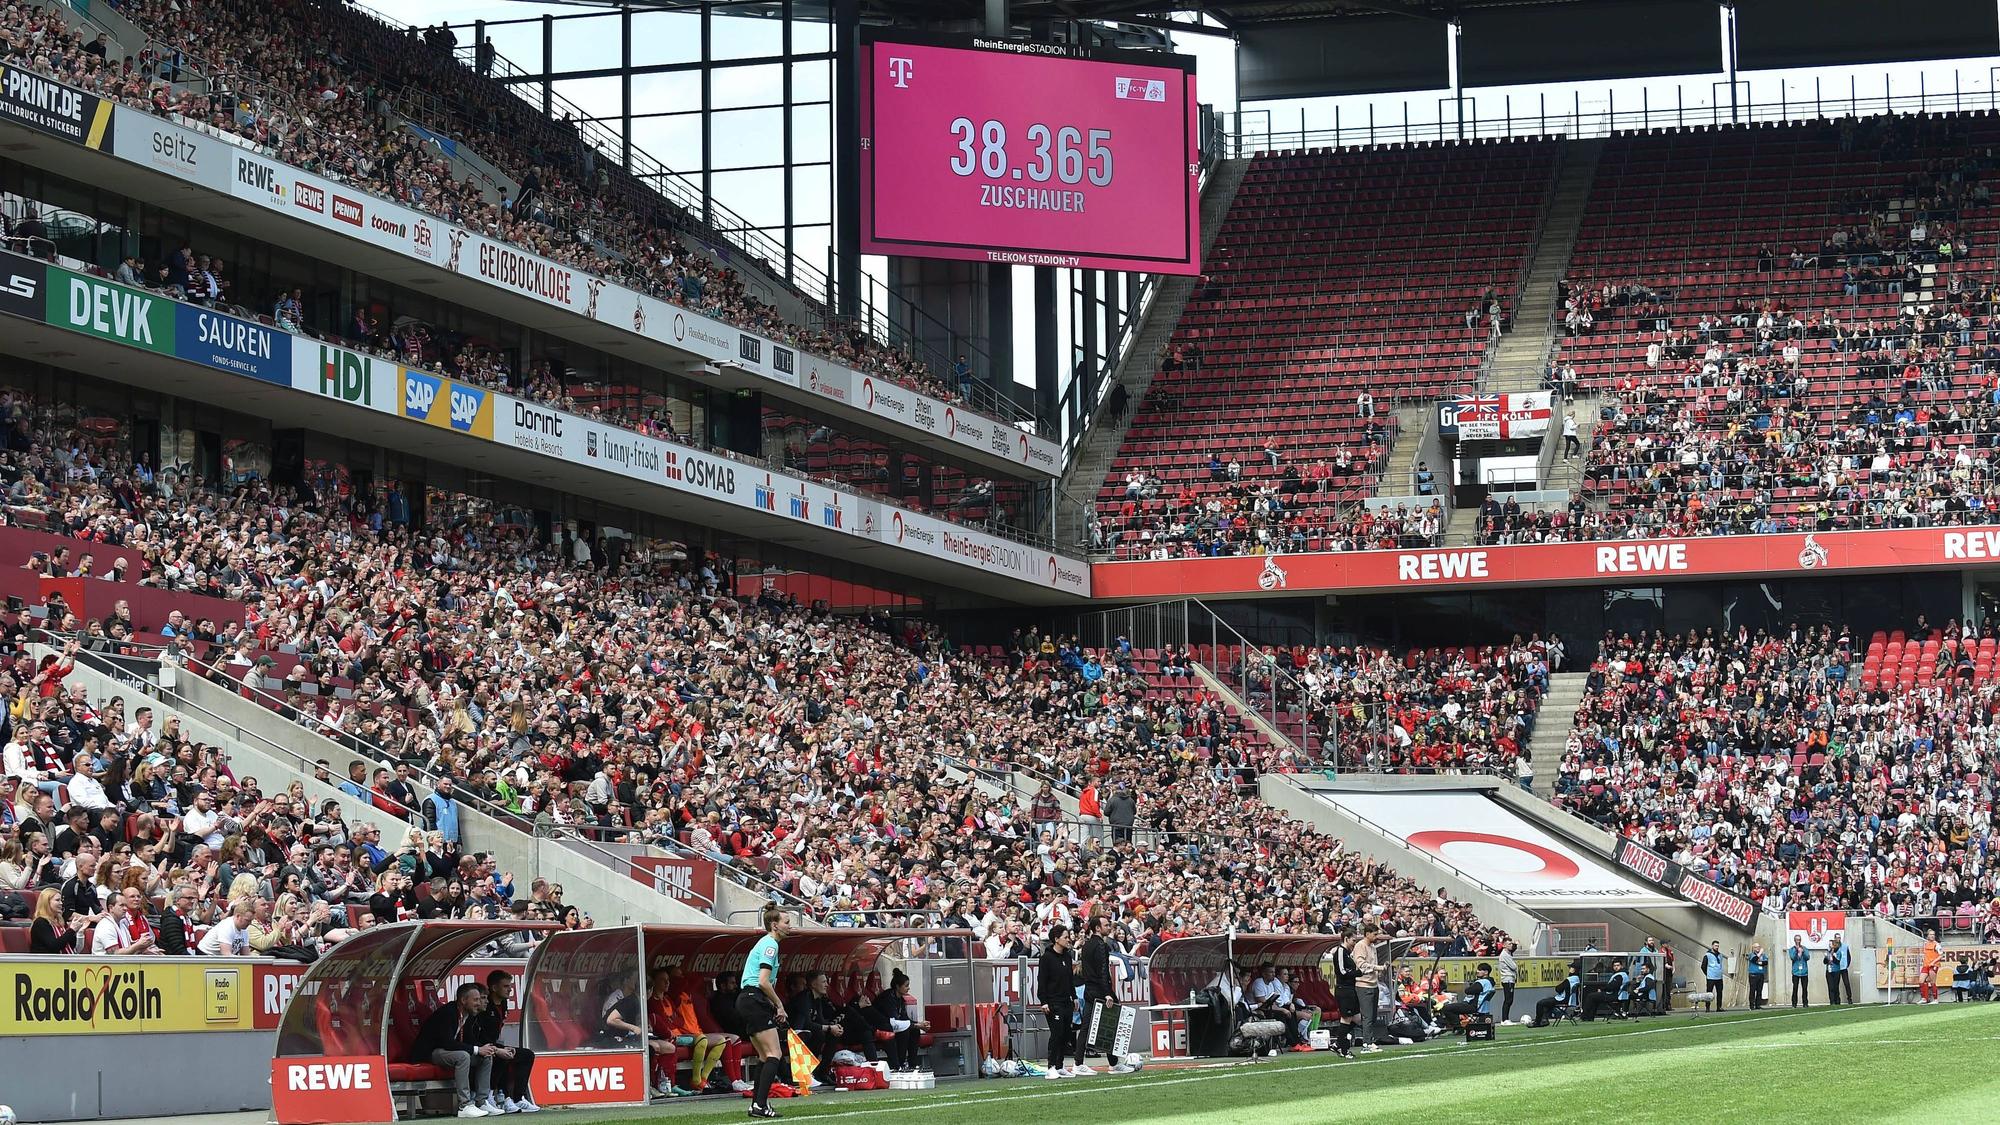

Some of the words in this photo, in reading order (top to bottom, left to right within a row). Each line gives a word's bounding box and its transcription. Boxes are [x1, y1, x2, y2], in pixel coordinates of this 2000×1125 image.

[973, 38, 1067, 56] RheinEnergieSTADION
[46, 117, 81, 137] STICKEREI
[152, 131, 197, 166] seitz
[949, 116, 1114, 187] 38.365
[238, 157, 275, 193] REWE
[295, 185, 323, 211] REWE
[979, 185, 1086, 213] ZUSCHAUER
[371, 214, 399, 236] toom
[413, 224, 431, 248] DER
[986, 251, 1027, 263] TELEKOM
[1028, 254, 1080, 266] STADION-TV
[70, 277, 153, 345] DEVK
[198, 313, 271, 360] SAUREN
[741, 337, 759, 360] UTH
[212, 354, 249, 372] FONDS-SERVICE
[250, 363, 257, 373] AG
[774, 349, 792, 372] UTH
[319, 345, 371, 406] HDI
[405, 378, 434, 413] SAP
[450, 391, 477, 424] SAP
[916, 397, 932, 415] Rhein
[515, 401, 563, 438] Dorint
[914, 408, 935, 430] Energie
[1476, 413, 1498, 421] 1.FC
[1501, 411, 1532, 421] KÖLN
[514, 431, 533, 450] Hotels
[534, 438, 540, 450] &
[540, 438, 563, 457] Resorts
[603, 432, 660, 472] funny-frisch
[684, 456, 735, 495] OSMAB
[904, 523, 934, 545] RheinEnergie
[1399, 551, 1489, 581] REWE
[1596, 543, 1688, 573] REWE
[1619, 841, 1667, 883] MATTES
[654, 864, 693, 899] REWE
[1679, 874, 1754, 926] UNBESIEGBAR
[15, 968, 95, 1022] Radio
[103, 970, 162, 1020] Köln
[288, 1063, 372, 1091] REWE
[547, 1066, 626, 1093] REWE
